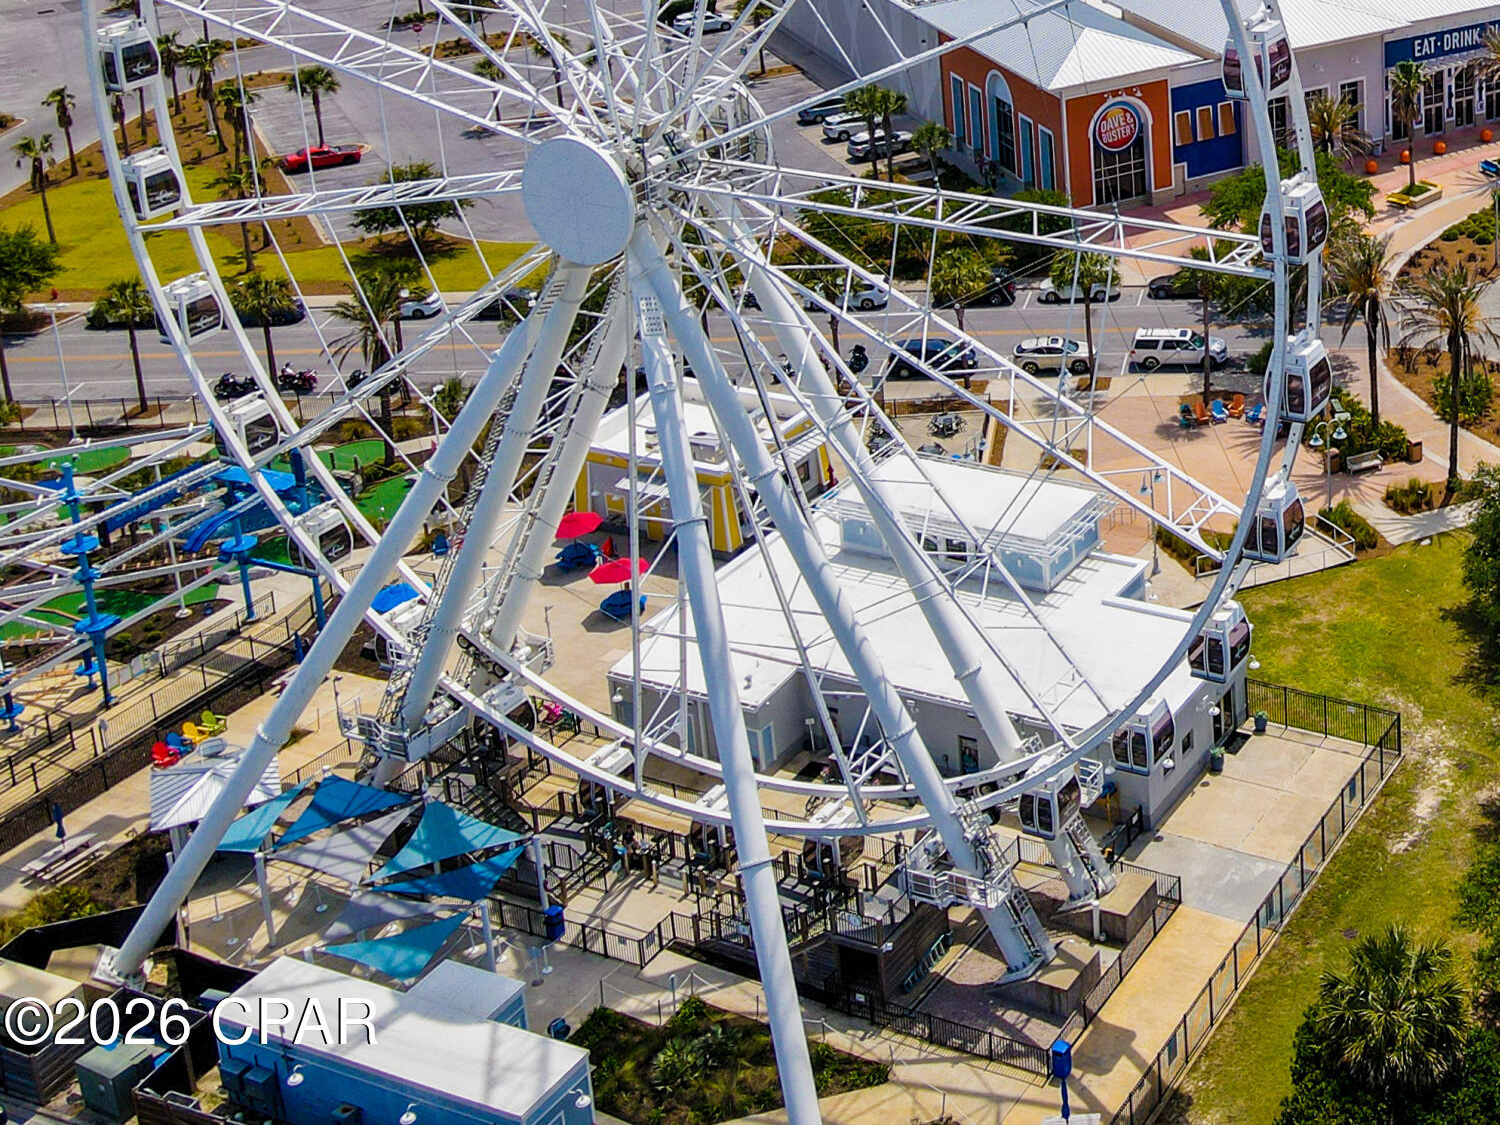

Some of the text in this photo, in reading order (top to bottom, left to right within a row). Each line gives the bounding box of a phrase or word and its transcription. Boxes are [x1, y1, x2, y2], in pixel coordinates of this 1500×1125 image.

[1414, 36, 1436, 57] EAT
[1443, 27, 1480, 51] DRINK
[1100, 112, 1134, 133] DAVE &
[1101, 123, 1136, 144] BUSTER'S
